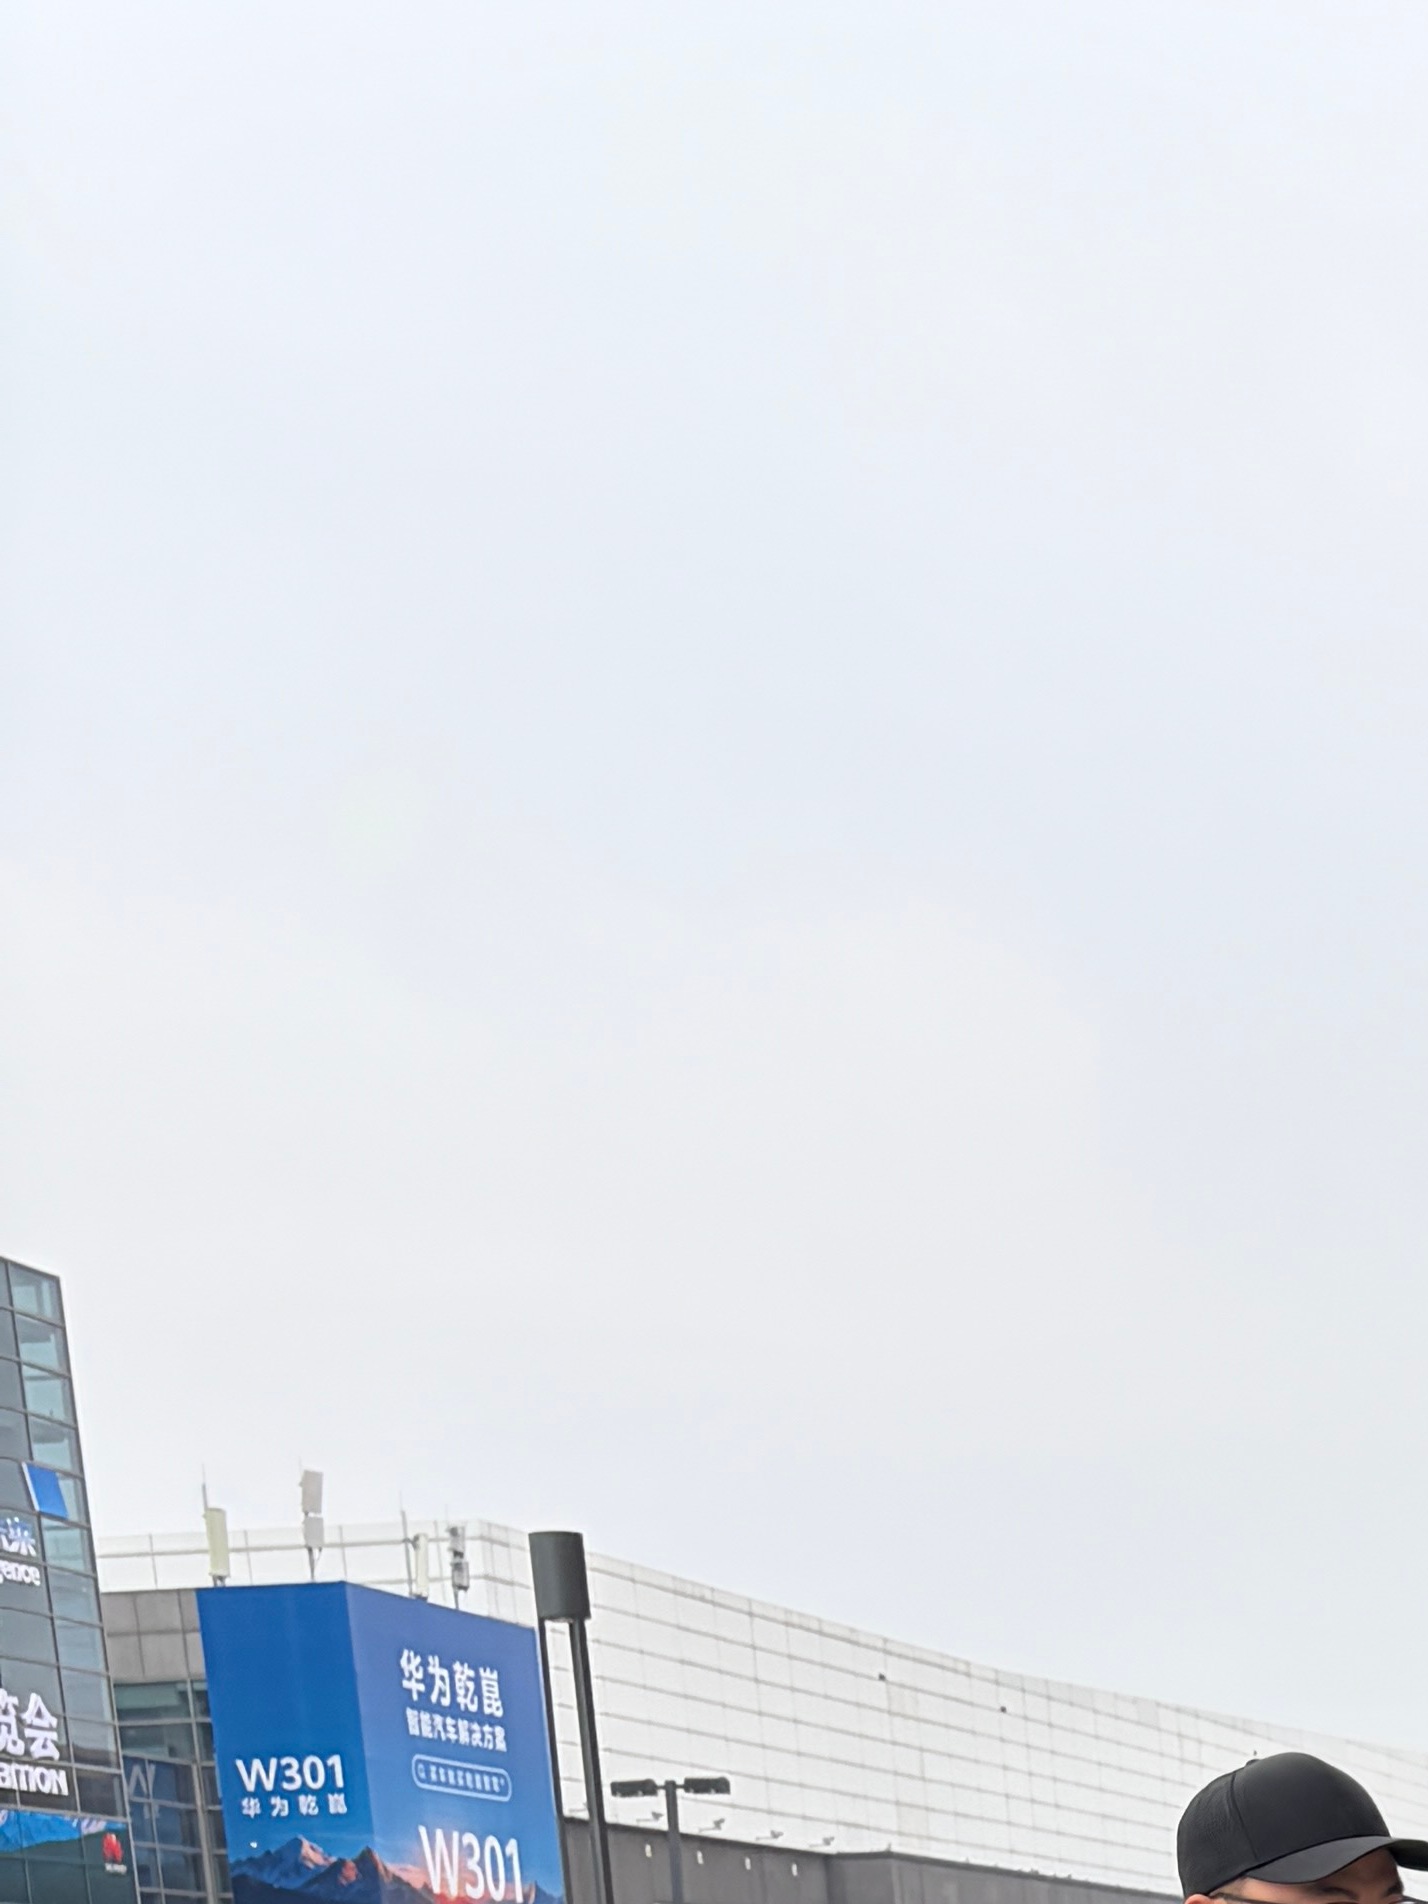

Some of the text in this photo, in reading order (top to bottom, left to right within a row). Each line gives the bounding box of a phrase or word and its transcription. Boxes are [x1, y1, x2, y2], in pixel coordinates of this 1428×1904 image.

[0, 1559, 41, 1586] ence
[400, 1648, 504, 1718] 华为乾崑
[235, 1754, 345, 1793] W301
[418, 1824, 524, 1904] W301
